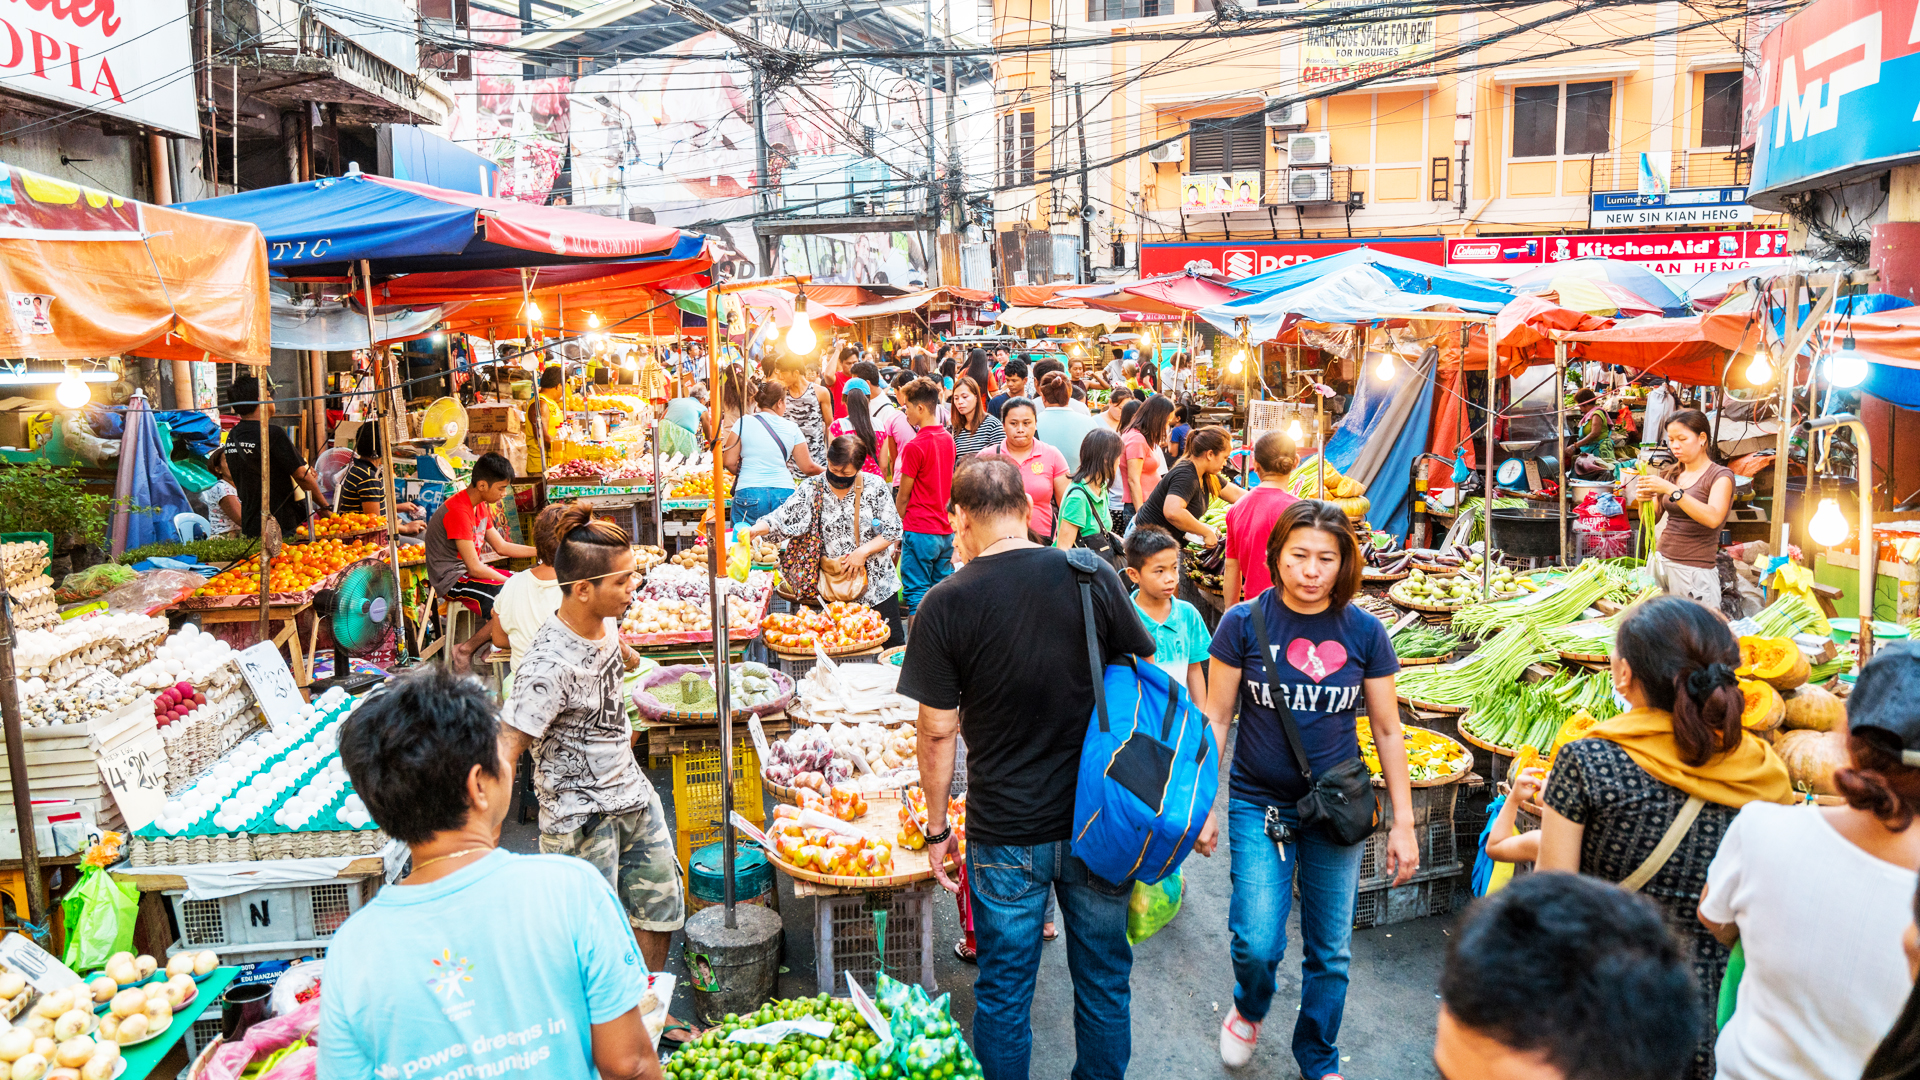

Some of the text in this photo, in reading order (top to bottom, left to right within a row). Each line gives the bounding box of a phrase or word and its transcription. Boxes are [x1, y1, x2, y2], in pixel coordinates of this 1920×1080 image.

[1307, 21, 1433, 47] WAREHOUSE SPACE FOR RENT
[1336, 47, 1399, 57] FOR INQUIRIES
[1303, 66, 1350, 83] CECILE
[1606, 209, 1739, 223] NEW SIN KIAN HENG
[272, 238, 332, 261] TIC
[572, 236, 645, 255] MICROMATIC
[1456, 245, 1490, 256] Coleman
[1577, 239, 1711, 257] KitchenAid
[108, 767, 128, 793] 4
[128, 751, 160, 790] 20
[249, 899, 271, 928] N
[240, 971, 283, 983] EDU MANZANO
[472, 1023, 543, 1055] dreams
[547, 1017, 567, 1035] in
